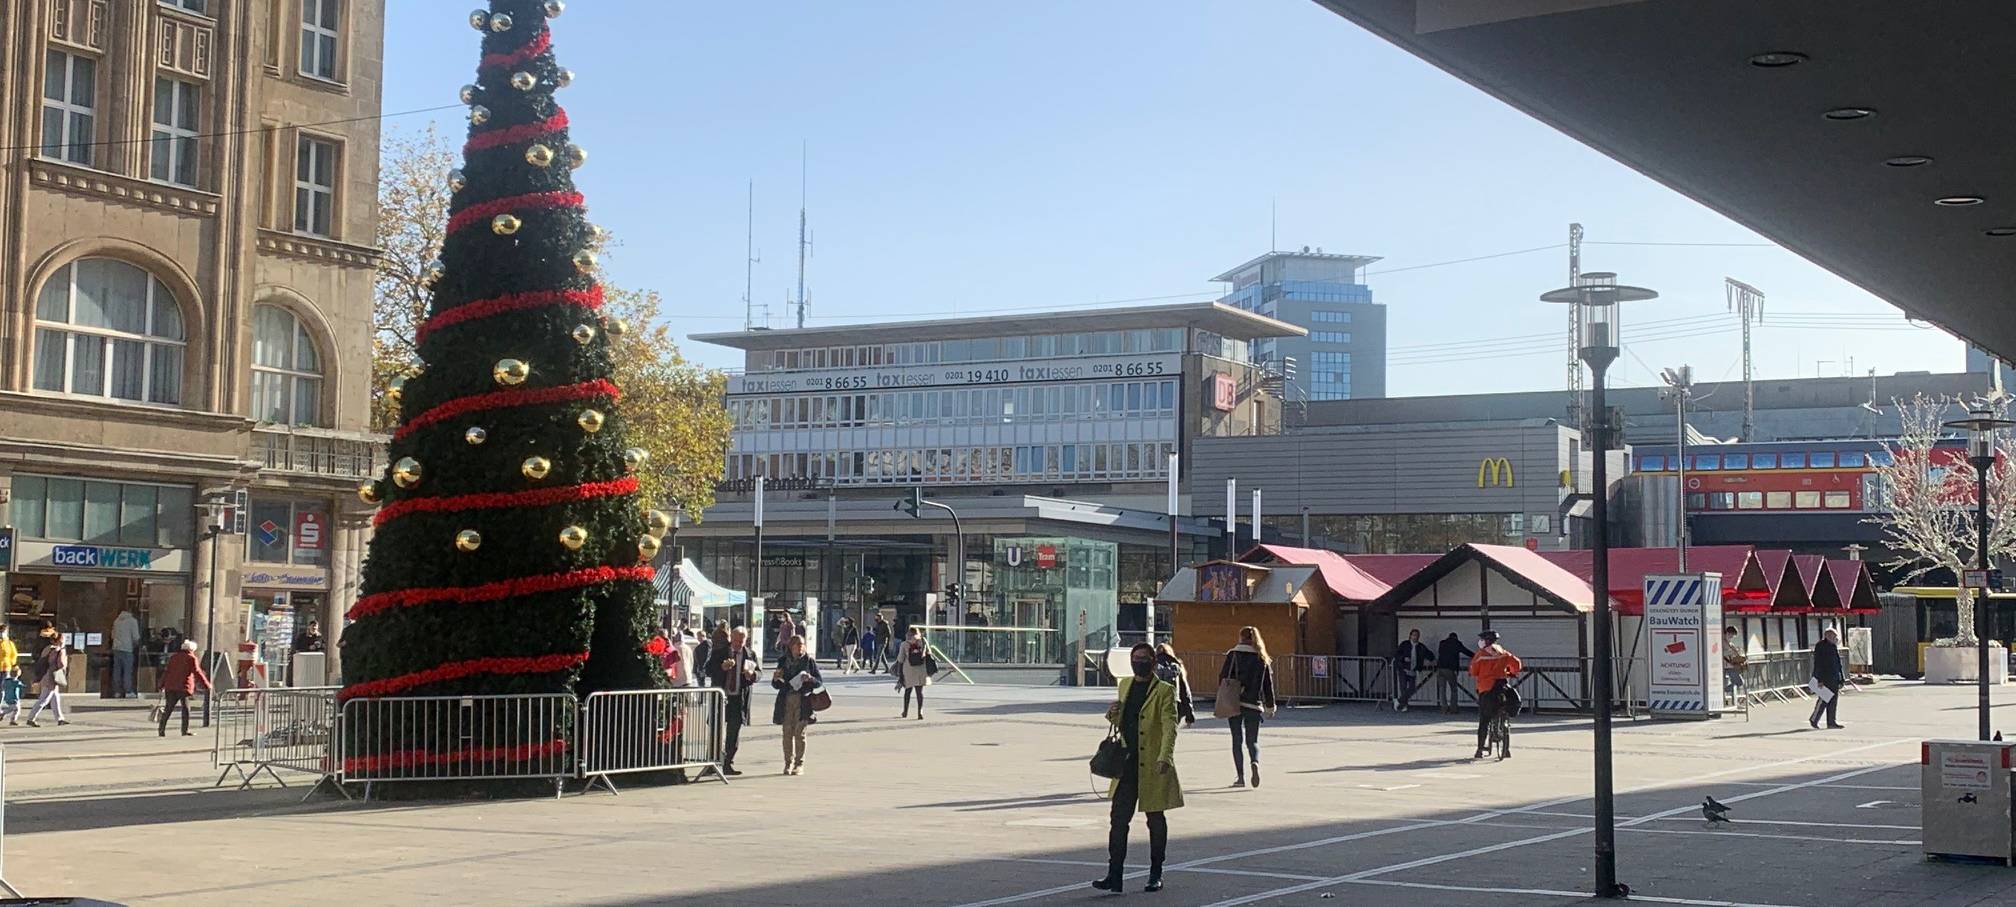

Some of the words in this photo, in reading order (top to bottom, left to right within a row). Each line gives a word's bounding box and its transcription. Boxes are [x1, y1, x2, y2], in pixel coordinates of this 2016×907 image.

[806, 378, 823, 386] 0201
[825, 377, 832, 389] 8
[853, 375, 867, 388] 55
[944, 371, 964, 380] 0201
[967, 370, 982, 383] 19
[985, 368, 1009, 382] 410
[1092, 364, 1113, 373] 0201
[1115, 363, 1123, 376] 8
[1147, 361, 1163, 375] 55
[1007, 547, 1022, 567] U
[1649, 615, 1699, 625] BauWatch
